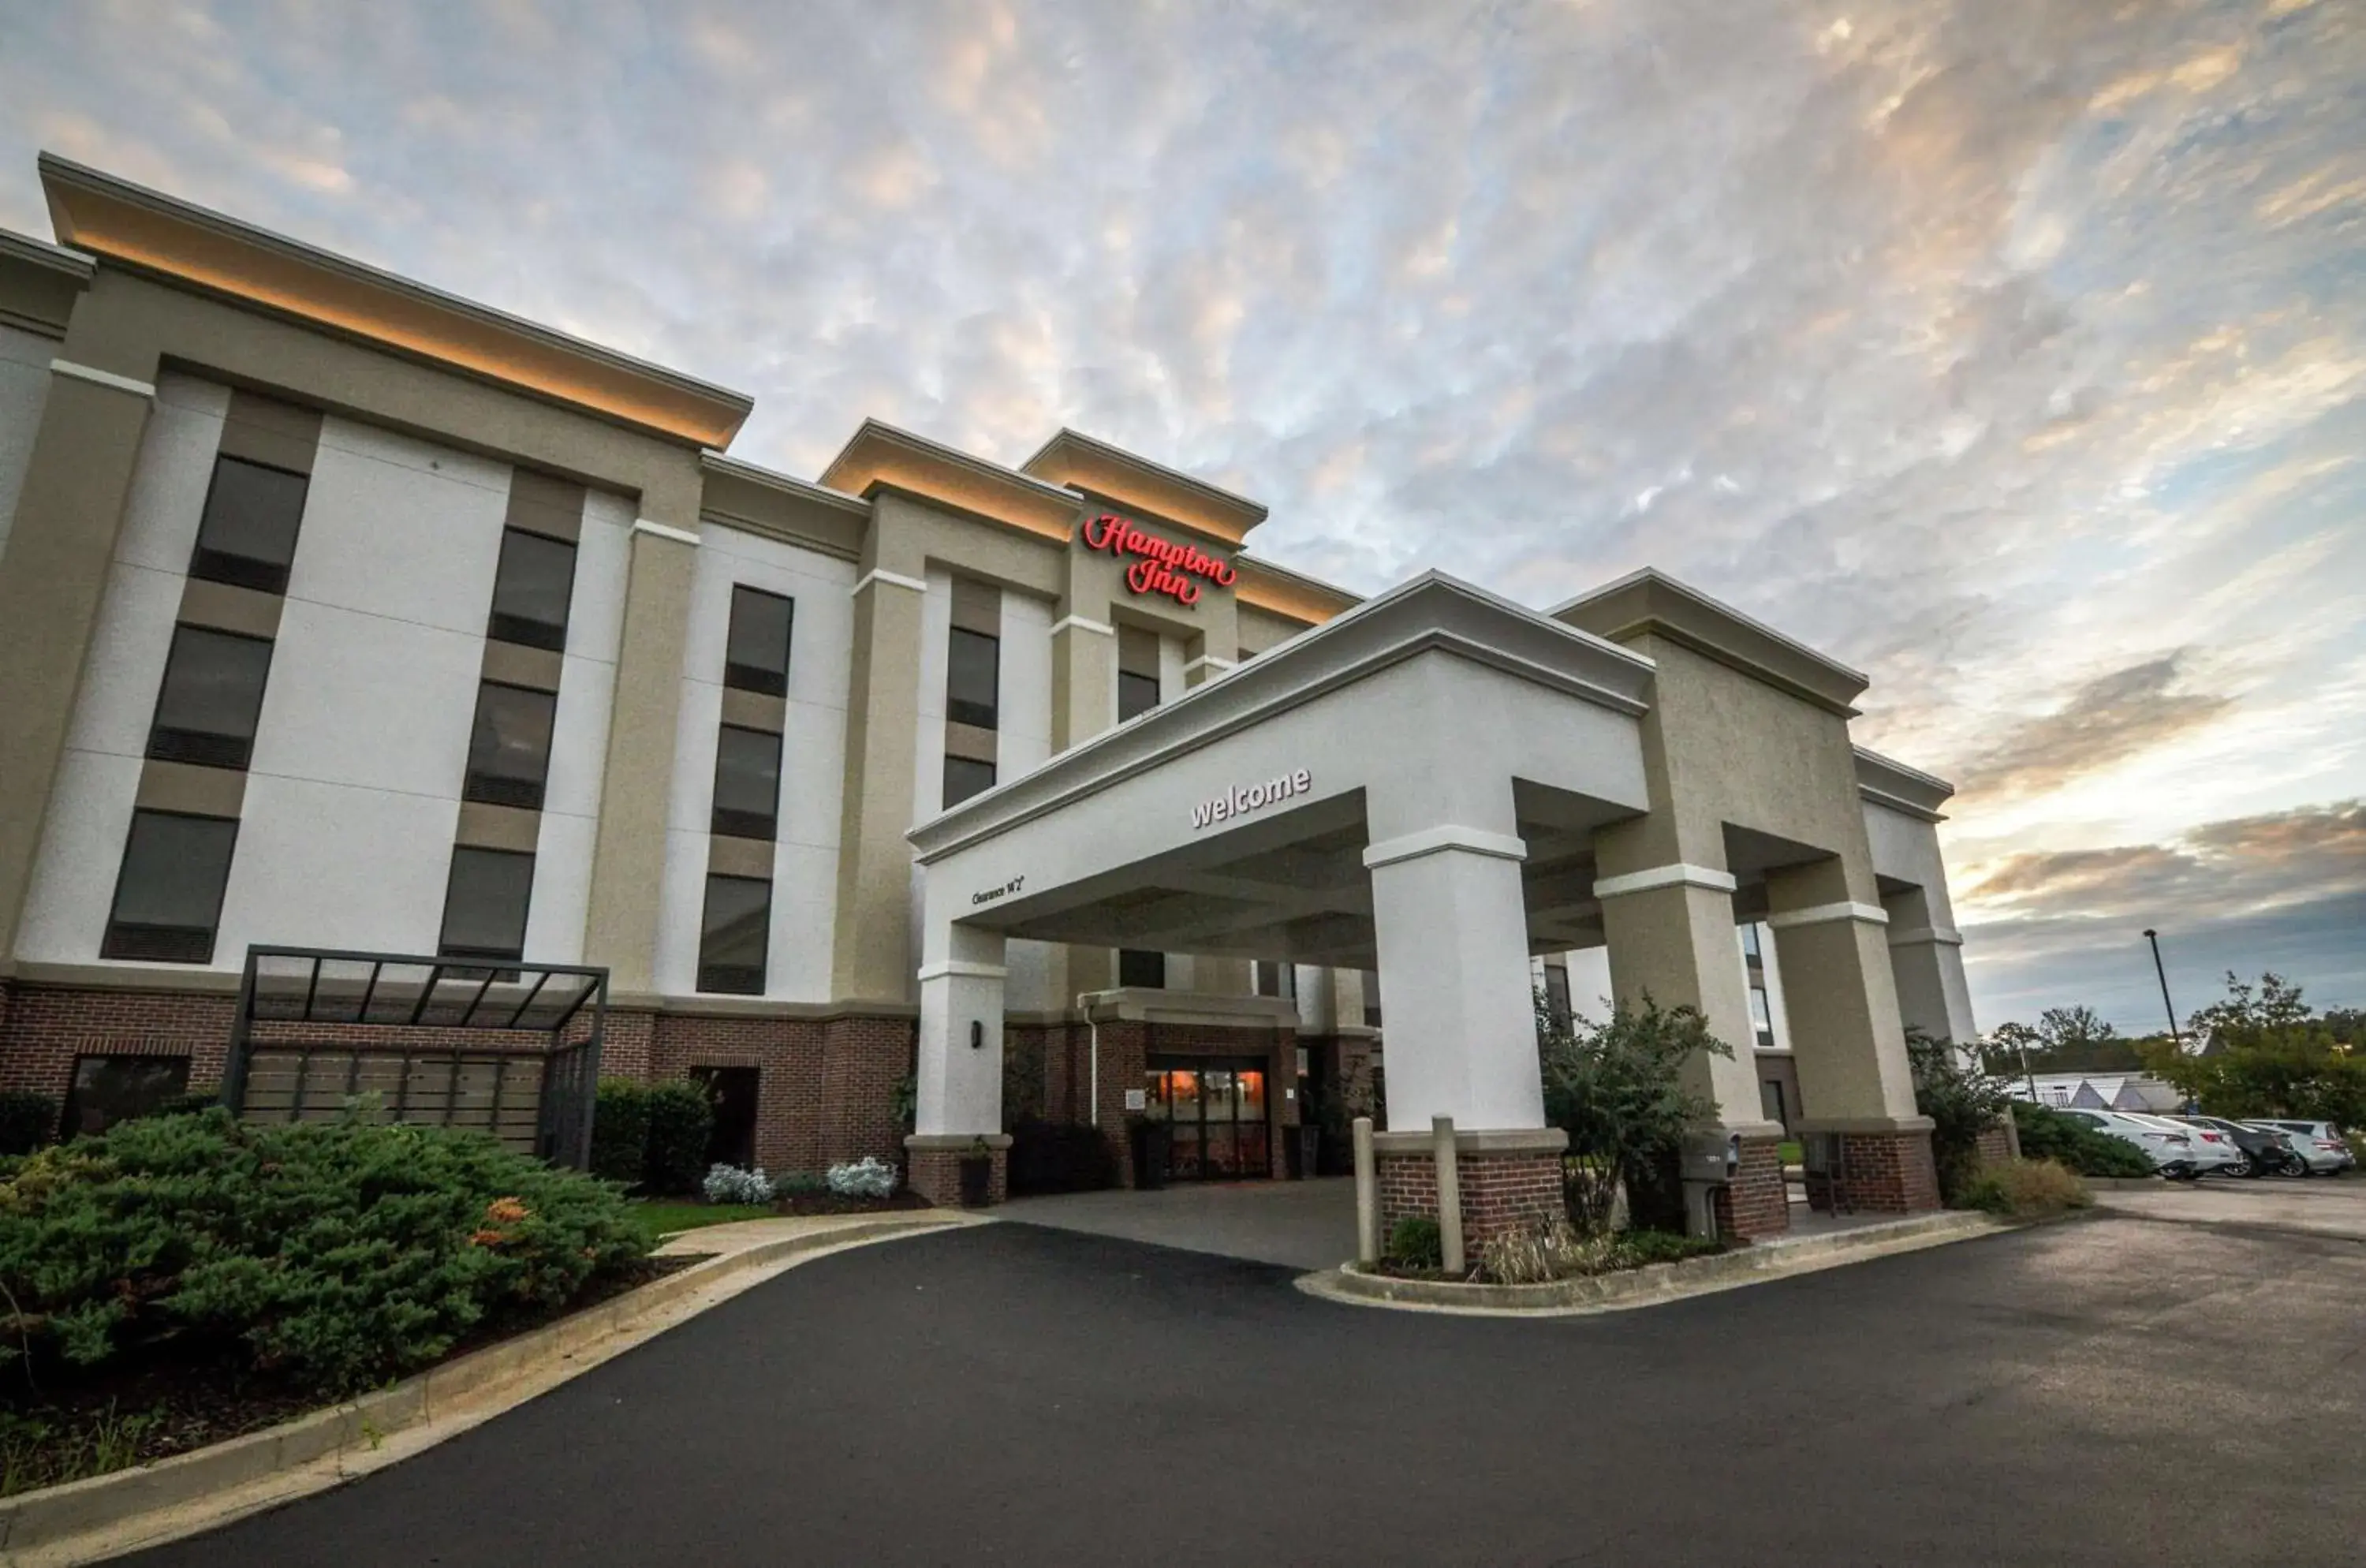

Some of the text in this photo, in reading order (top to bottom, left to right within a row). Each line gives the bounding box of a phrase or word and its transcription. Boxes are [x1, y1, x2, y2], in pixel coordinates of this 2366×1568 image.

[1084, 513, 1237, 586] Hampton
[1127, 559, 1202, 605] Inn
[1192, 768, 1311, 828] welcome
[972, 887, 1005, 905] Clearance
